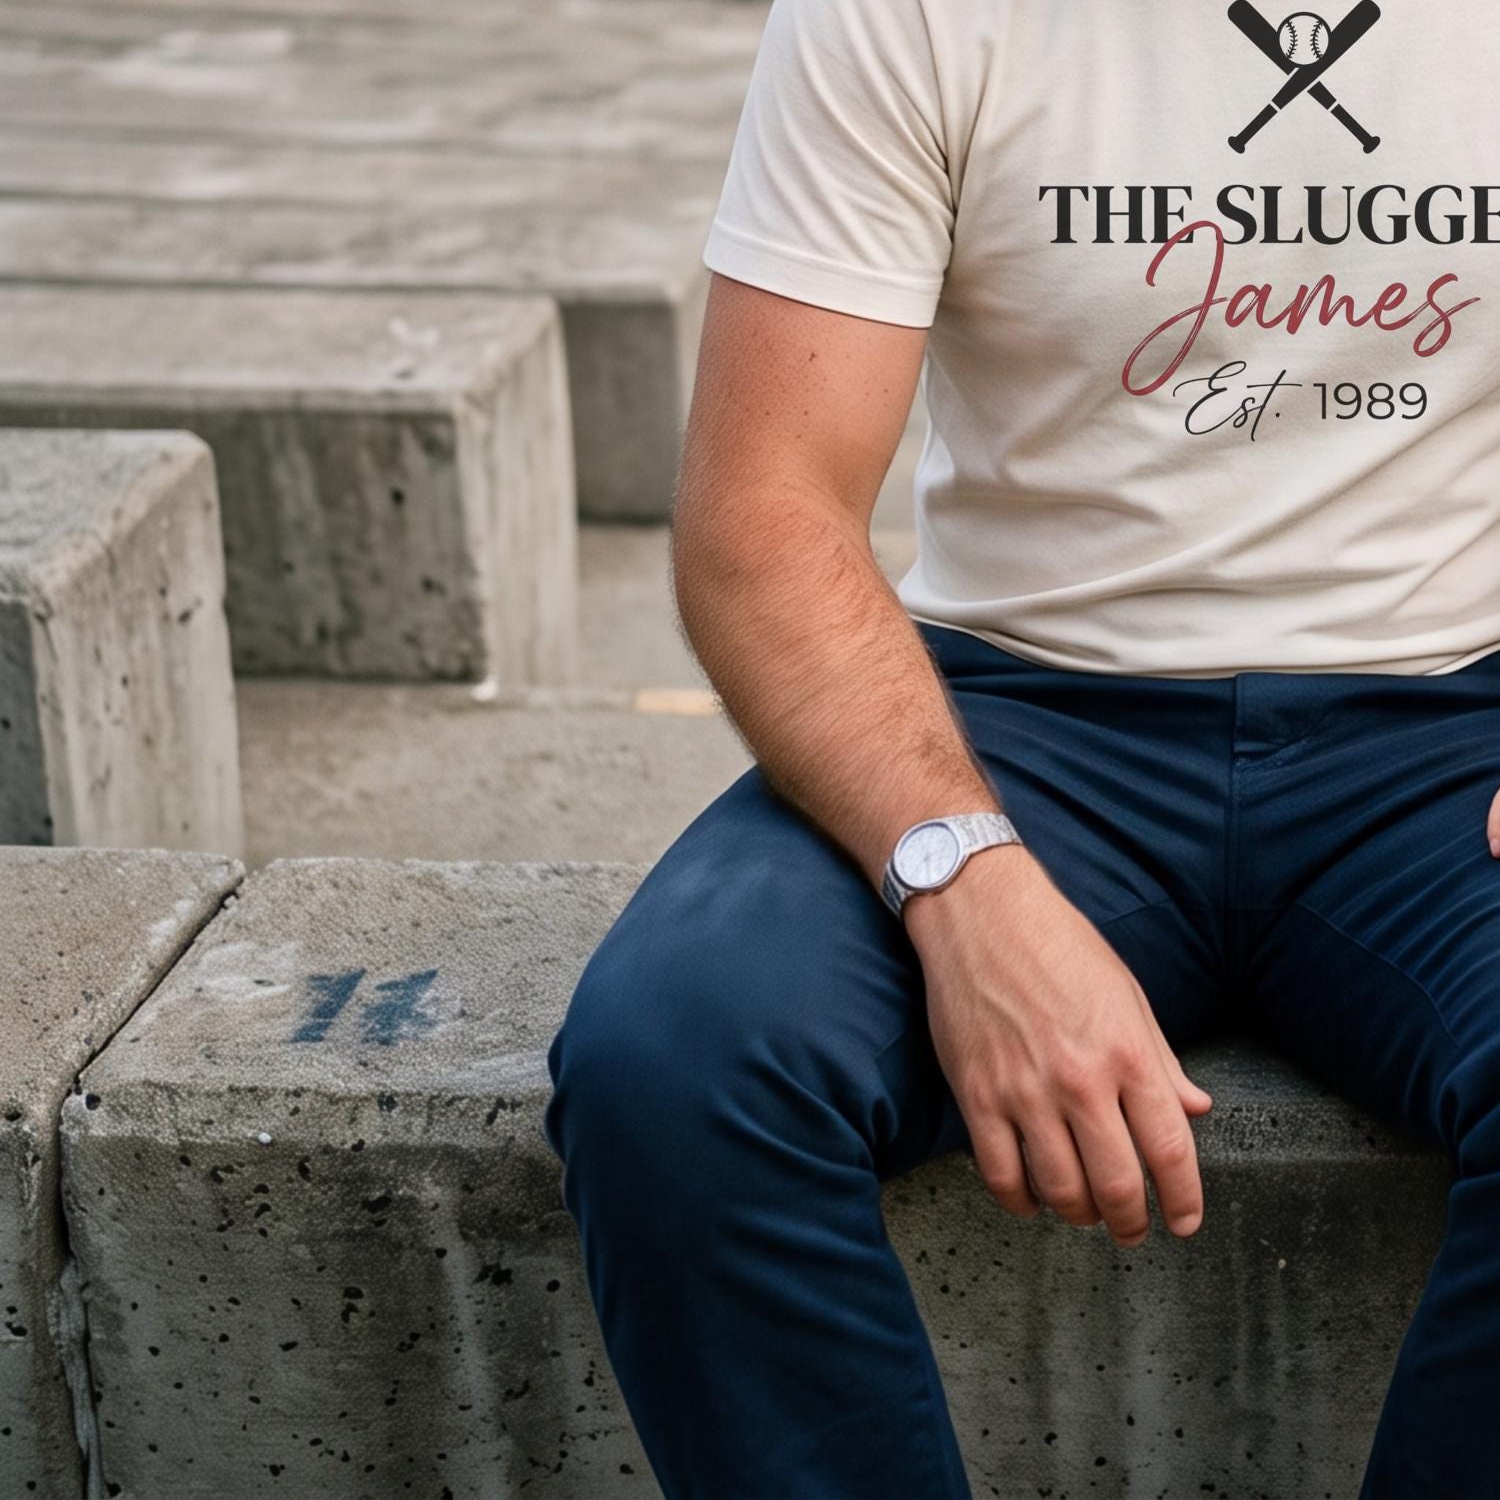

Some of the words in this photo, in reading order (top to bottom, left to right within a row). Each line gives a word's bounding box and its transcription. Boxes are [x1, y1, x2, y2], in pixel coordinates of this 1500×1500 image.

[1039, 185, 1194, 244] THE
[1121, 220, 1481, 396] James
[1173, 360, 1303, 442] Est.
[1313, 382, 1428, 420] 1989
